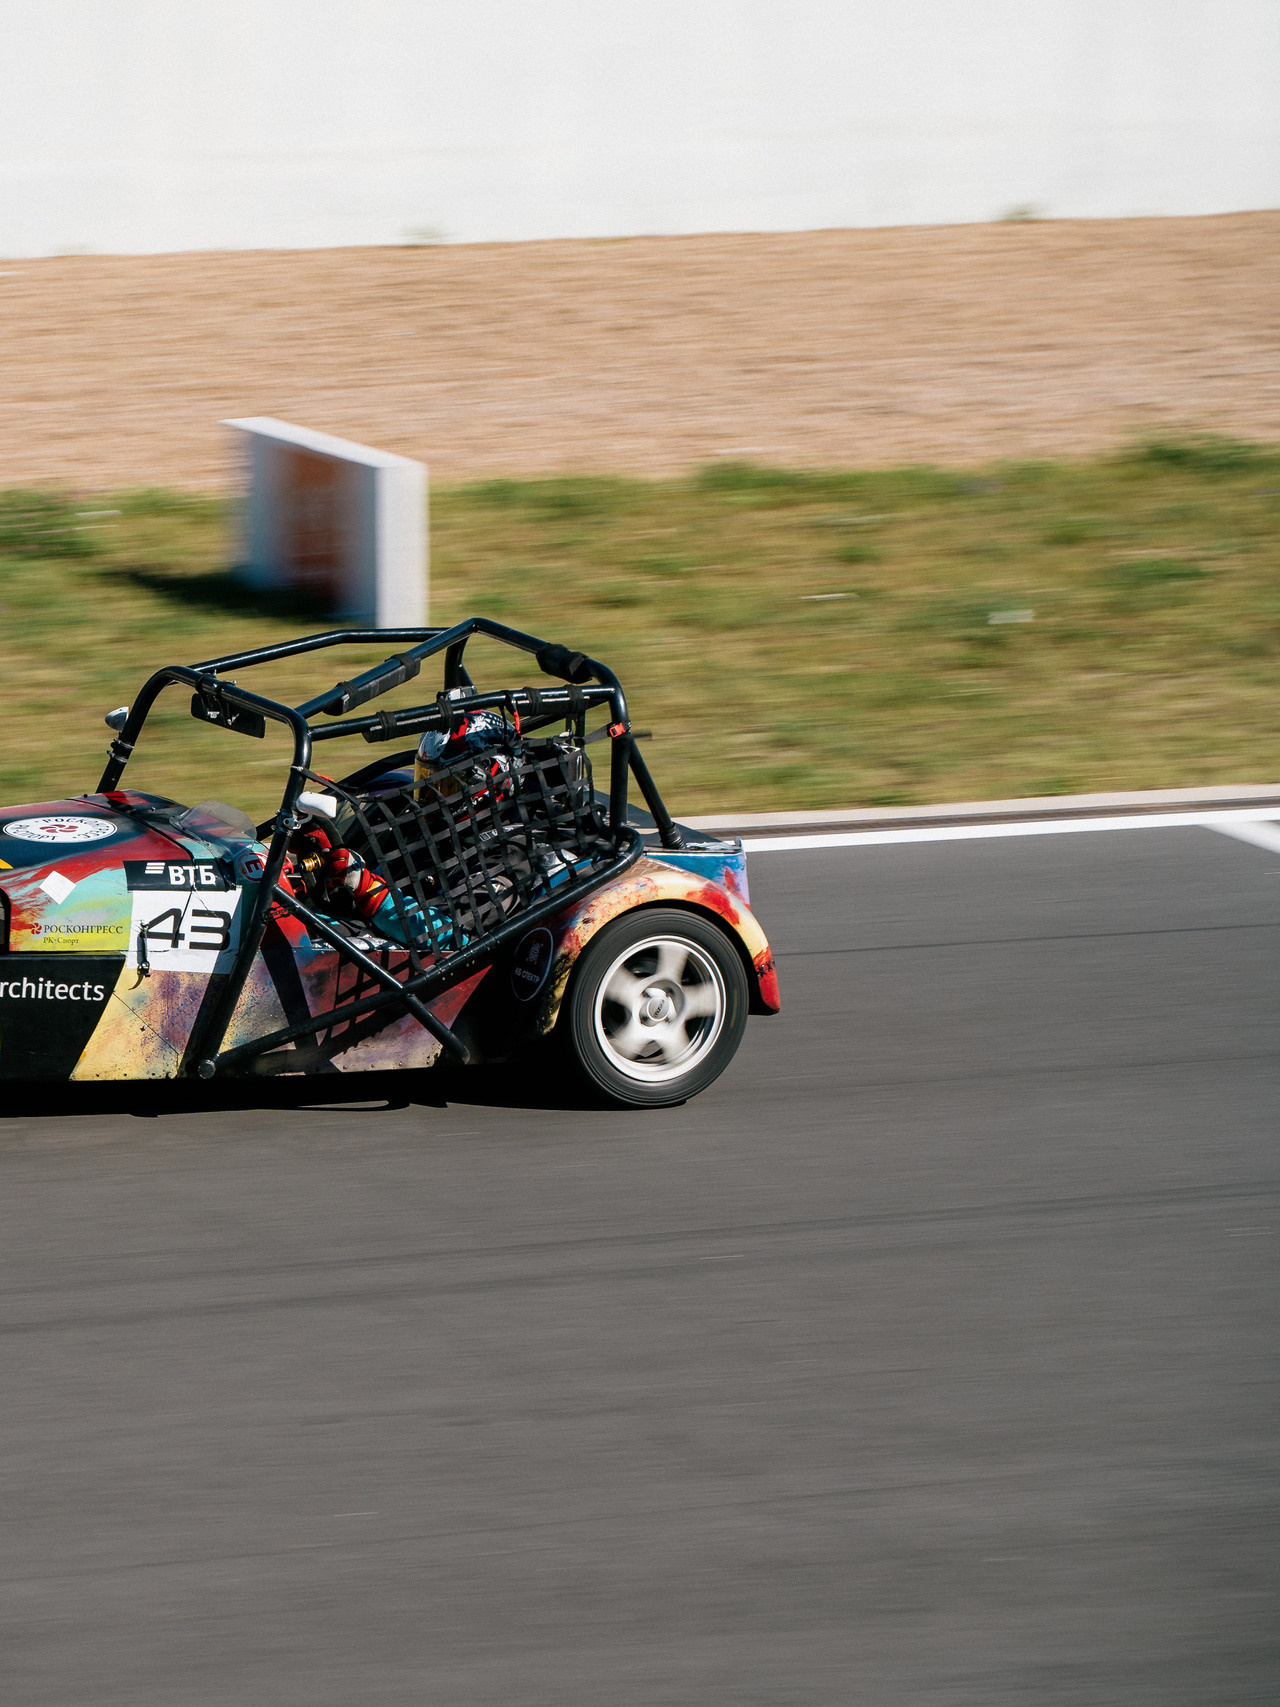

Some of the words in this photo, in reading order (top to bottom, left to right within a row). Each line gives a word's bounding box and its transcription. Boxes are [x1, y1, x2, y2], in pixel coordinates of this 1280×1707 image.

[168, 864, 216, 886] ВТБ
[43, 923, 124, 935] РОСКОНГРЕСС
[145, 907, 232, 951] 43
